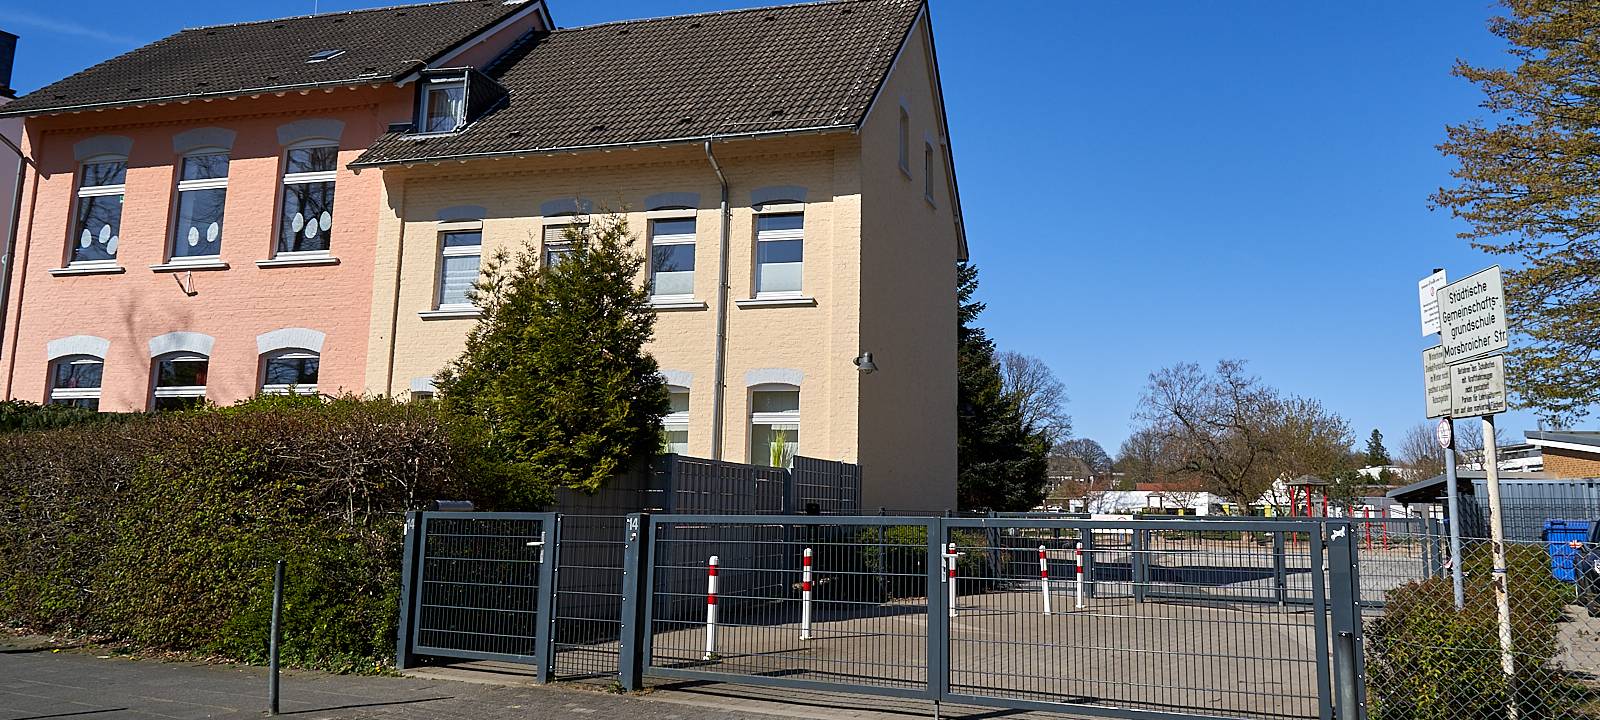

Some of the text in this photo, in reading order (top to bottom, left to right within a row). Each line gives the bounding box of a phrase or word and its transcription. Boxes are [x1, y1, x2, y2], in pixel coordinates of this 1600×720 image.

[1448, 281, 1487, 305] Städtische
[1442, 295, 1499, 324] Gemeinschafts-
[1450, 312, 1496, 340] grundschule
[1444, 335, 1491, 358] Morsbroicher
[406, 518, 415, 530] 14
[629, 517, 639, 531] 14
